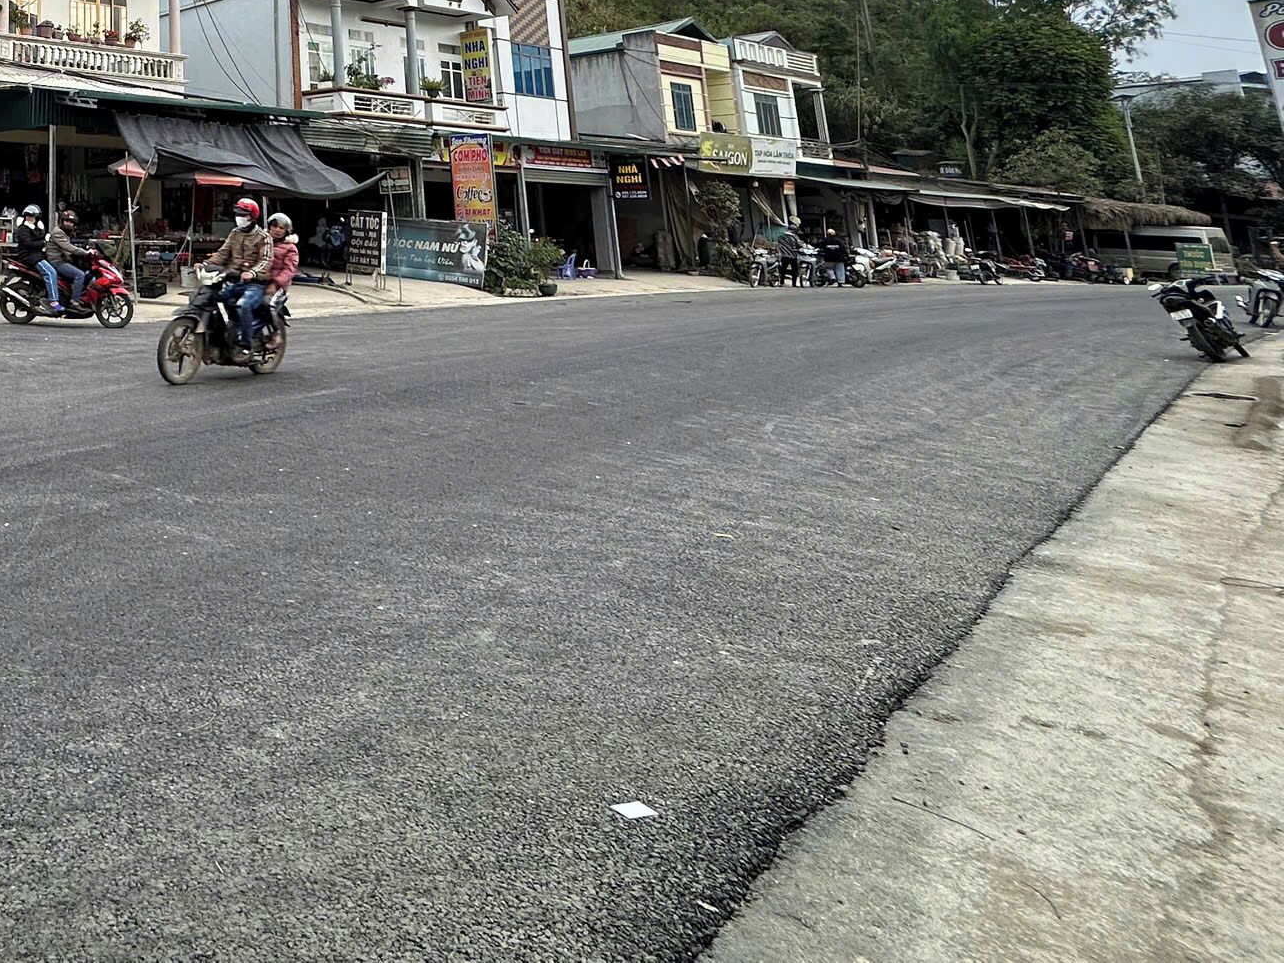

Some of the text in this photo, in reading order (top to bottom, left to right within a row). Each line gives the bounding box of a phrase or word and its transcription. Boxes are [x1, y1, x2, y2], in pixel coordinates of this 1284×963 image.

[618, 163, 638, 174] NHÀ
[457, 185, 483, 204] Coffee
[414, 240, 439, 252] NAM
